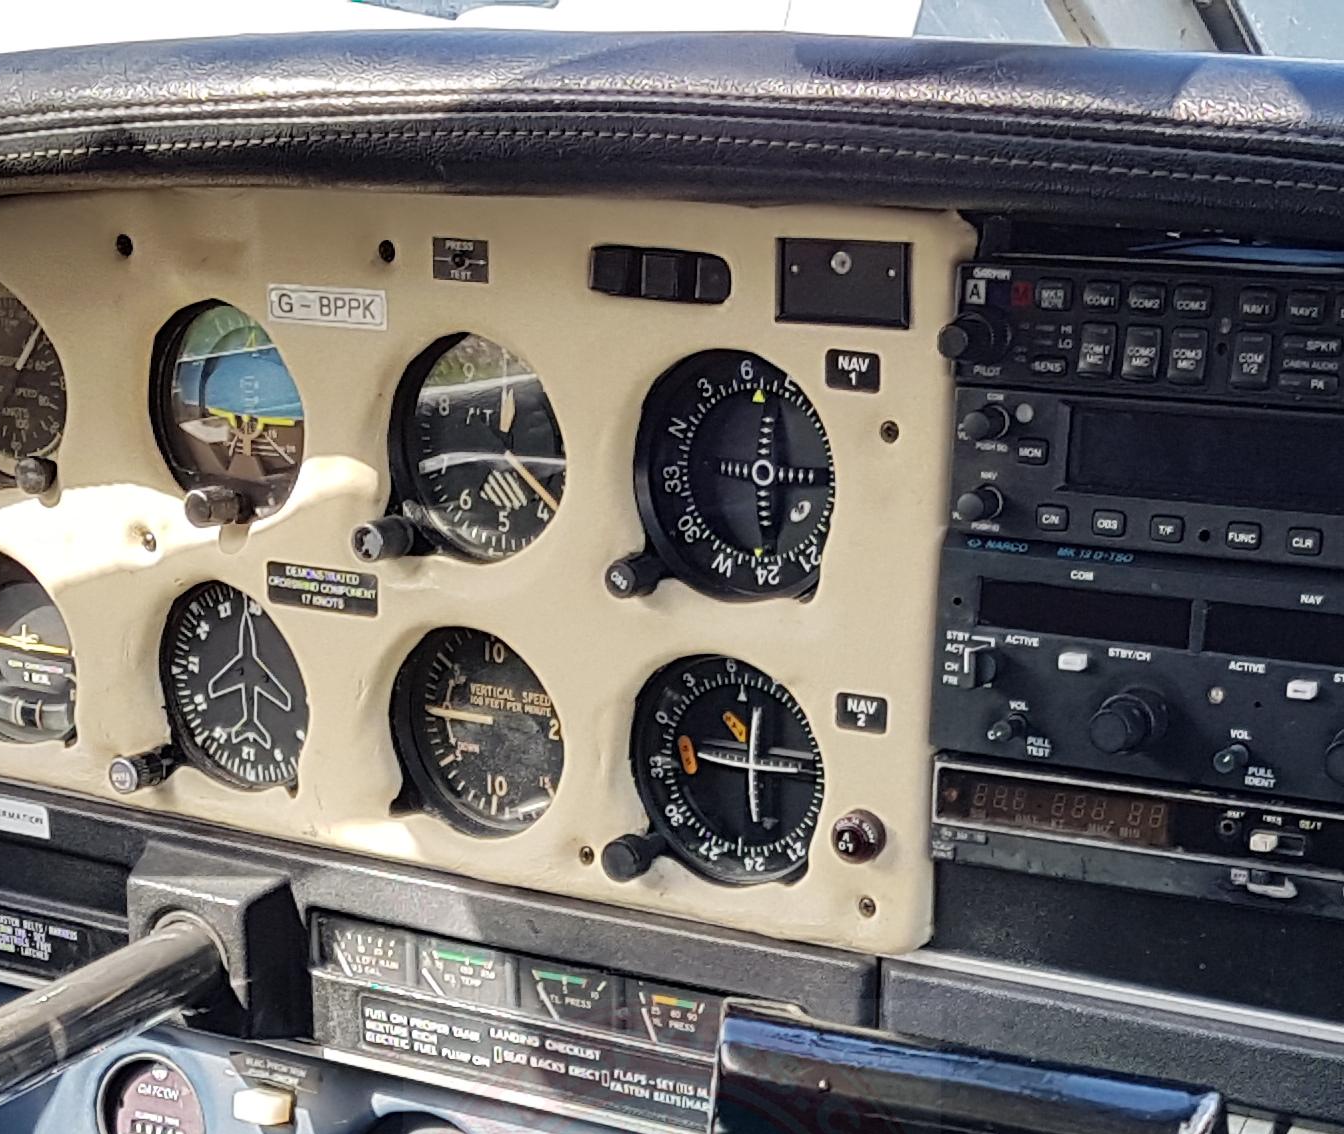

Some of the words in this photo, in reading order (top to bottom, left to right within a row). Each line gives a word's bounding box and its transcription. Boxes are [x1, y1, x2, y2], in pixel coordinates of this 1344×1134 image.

[740, 360, 753, 380] 6
[837, 355, 870, 373] NAV
[698, 377, 713, 396] 3
[849, 373, 857, 385] 1
[668, 417, 688, 438] N
[663, 466, 680, 493] 33
[459, 493, 472, 511] 6
[499, 511, 510, 532] 5
[1292, 537, 1314, 549] CLR
[1070, 569, 1094, 581] COM
[1300, 594, 1324, 606] NAV
[1005, 634, 1040, 647] ACTIVE
[484, 640, 505, 664] 10
[1228, 660, 1266, 674] ACTIVE
[470, 683, 516, 701] VERTICAL
[522, 691, 552, 707] SPEED
[847, 699, 878, 714] NAV
[548, 718, 560, 740] 2
[857, 714, 866, 726] 2
[487, 774, 507, 796] 10
[545, 1039, 601, 1061] CHECKLIST
